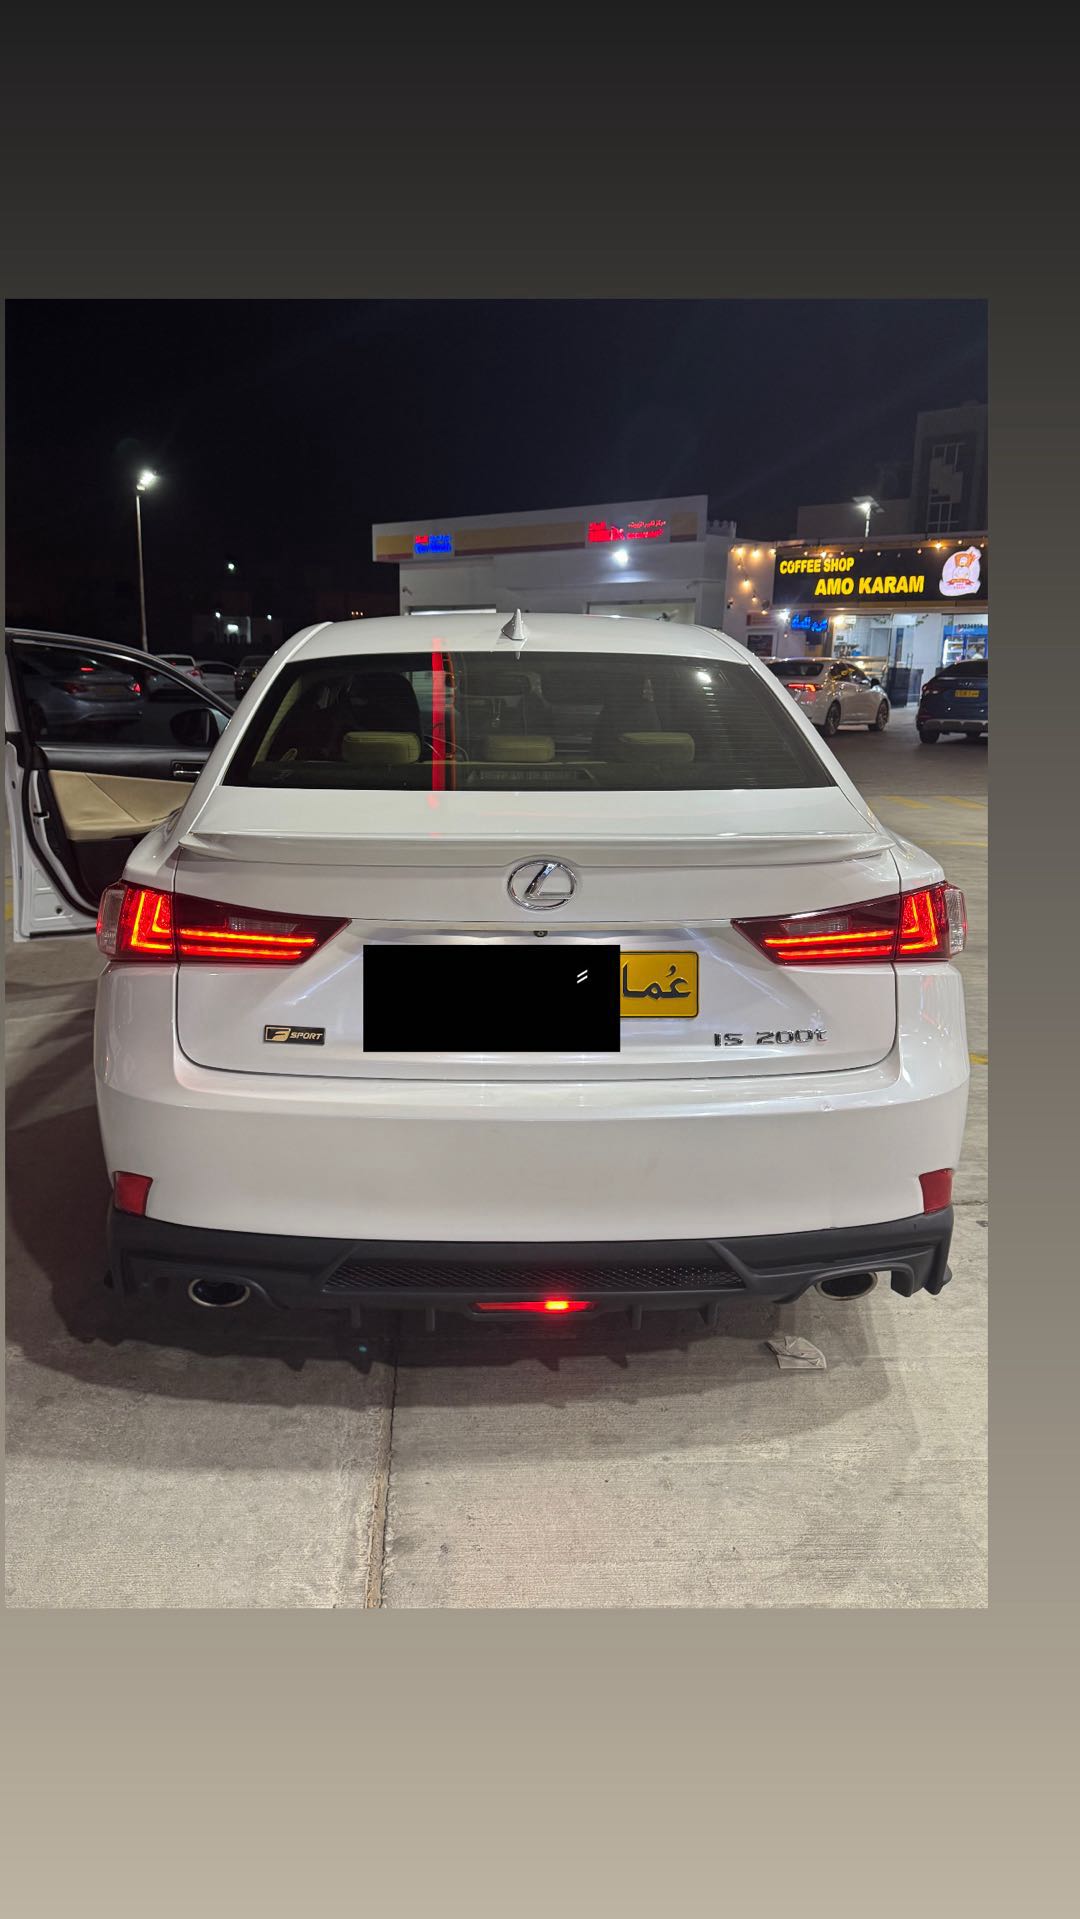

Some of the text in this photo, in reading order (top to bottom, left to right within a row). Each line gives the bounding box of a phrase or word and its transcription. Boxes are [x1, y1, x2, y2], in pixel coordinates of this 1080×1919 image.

[780, 557, 854, 574] COFFEE SHOP
[815, 575, 924, 595] AMO KARAM
[622, 963, 691, 1000] عُما
[289, 1031, 323, 1040] SPORT
[714, 1028, 828, 1046] IS 200t
